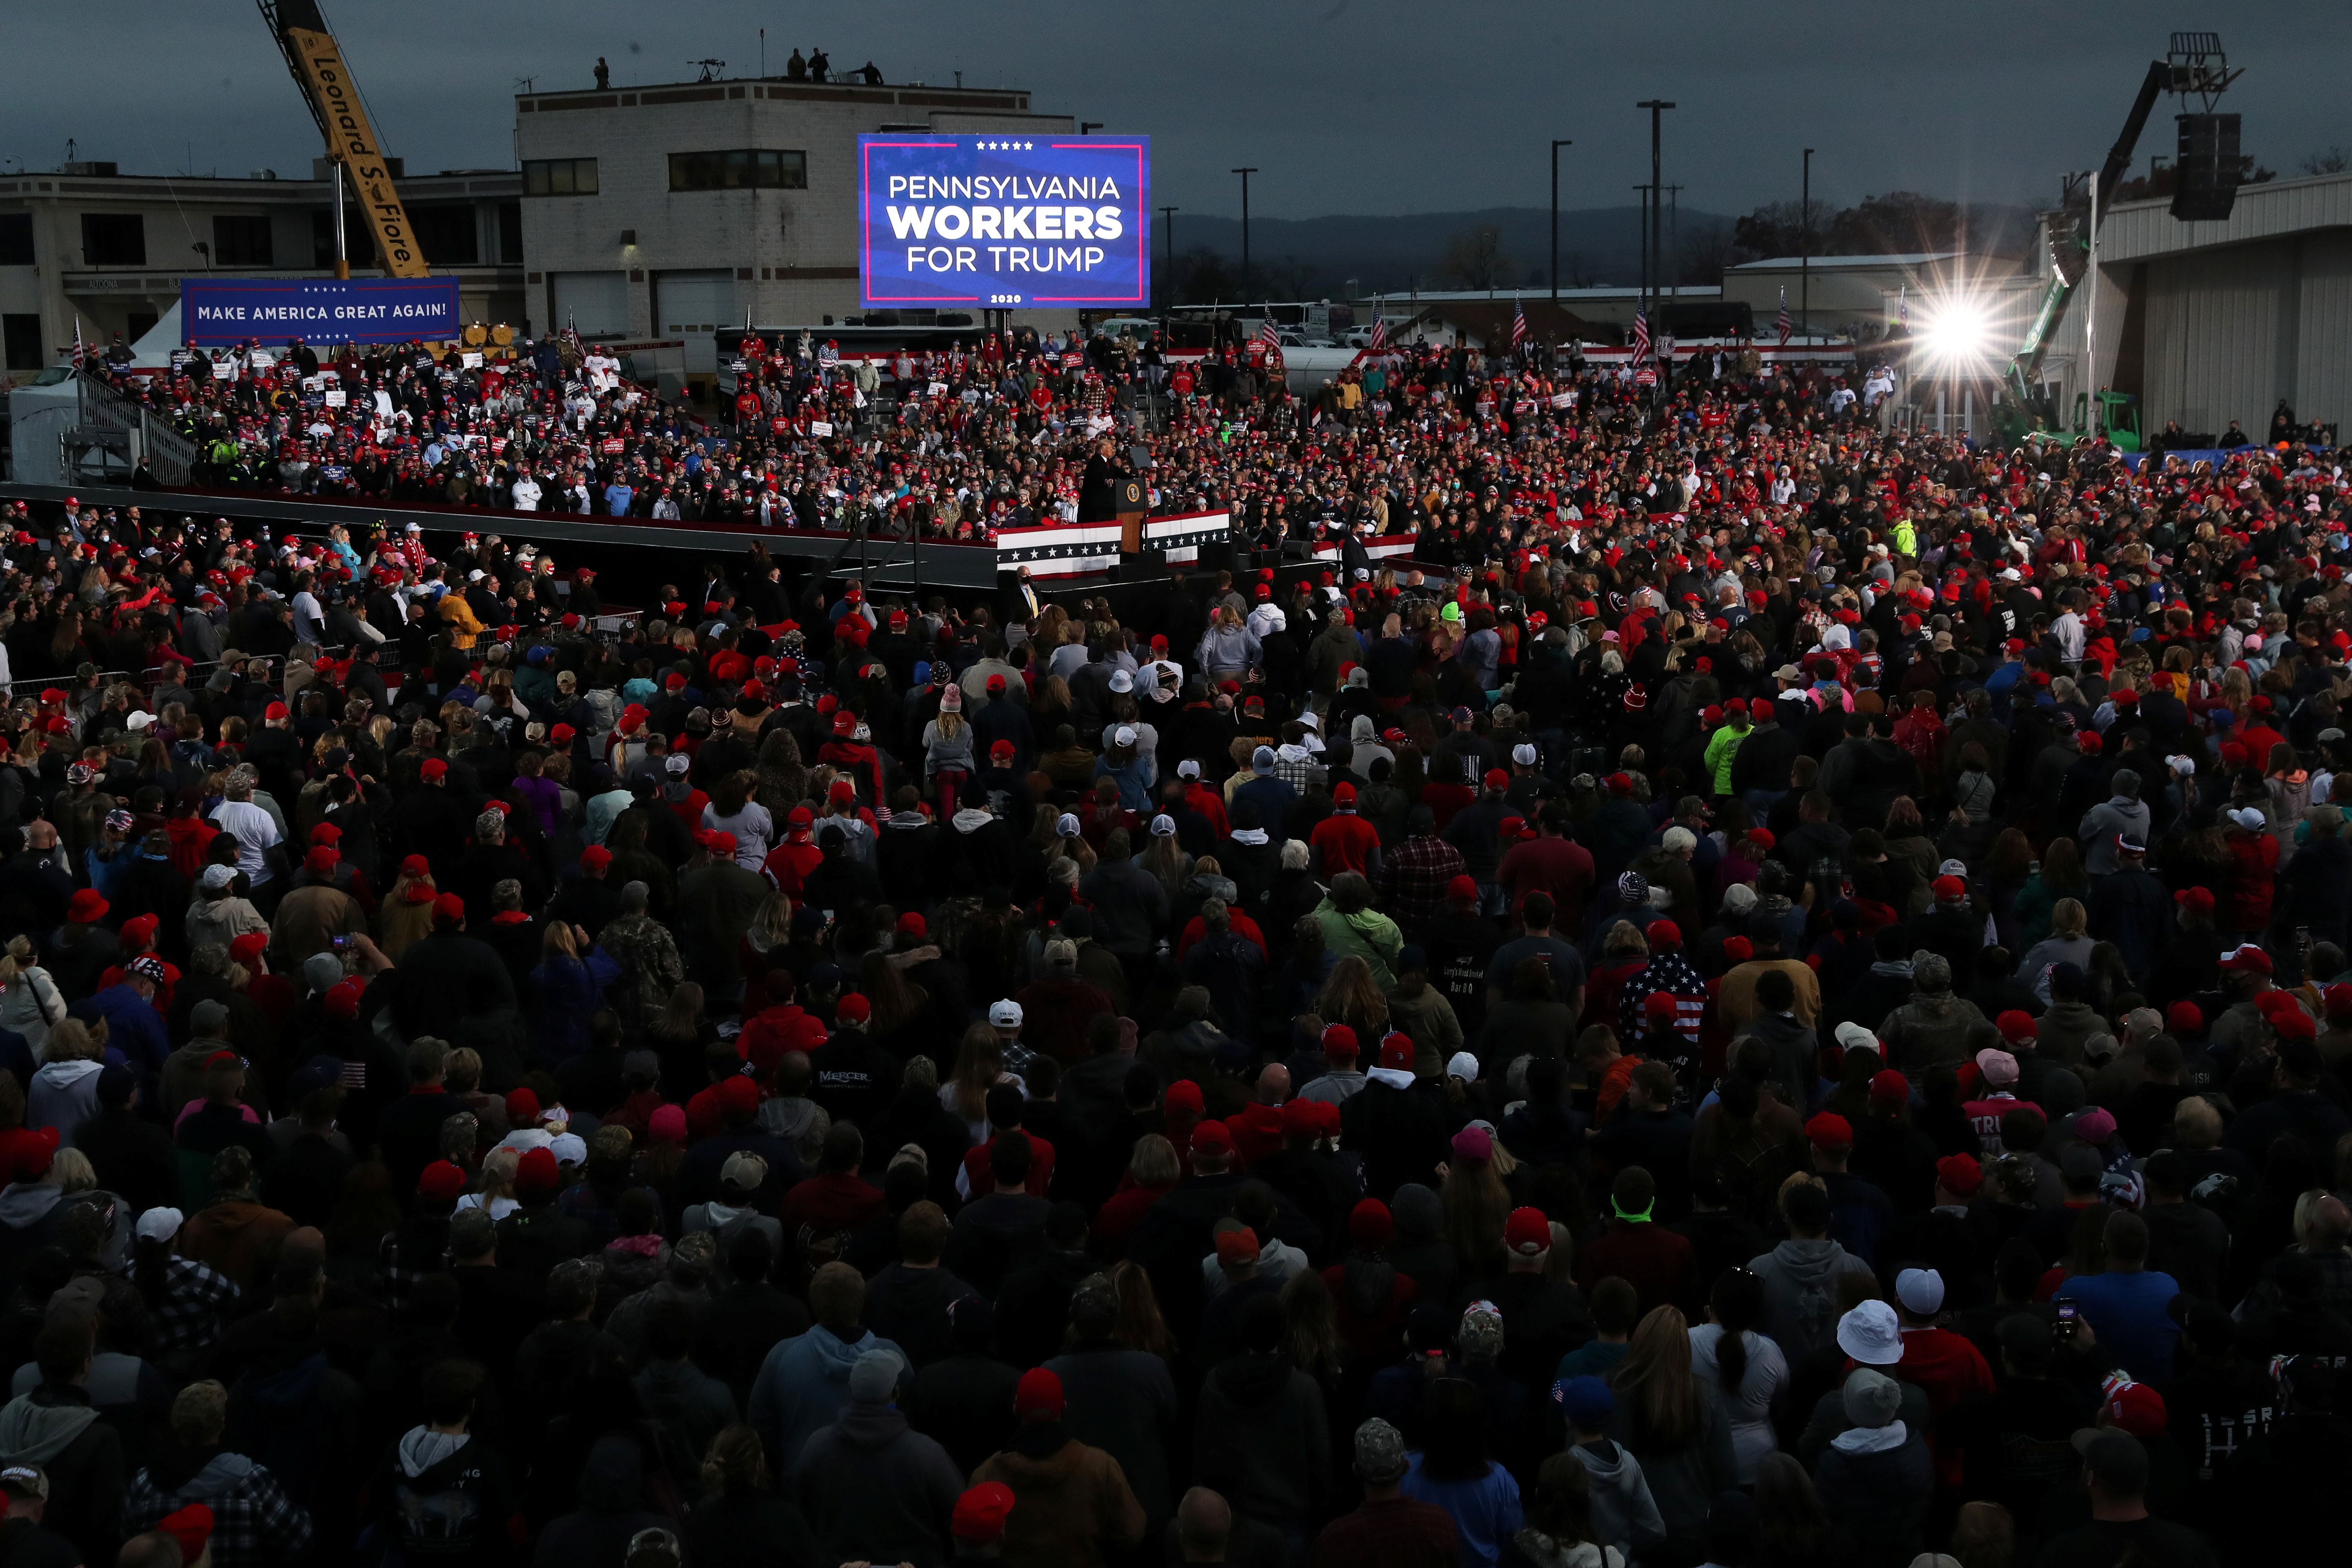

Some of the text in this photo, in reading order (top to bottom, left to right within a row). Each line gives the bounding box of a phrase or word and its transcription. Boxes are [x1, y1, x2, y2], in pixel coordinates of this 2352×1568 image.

[313, 57, 375, 157] Leonard
[375, 204, 411, 267] Fiore,
[890, 176, 1120, 199] PENNSYLVANIA
[886, 206, 1122, 239] WORKERS
[908, 247, 1103, 272] FOR TRUMP
[89, 279, 118, 289] ALTOONA
[168, 279, 181, 288] BLA
[198, 303, 446, 320] MAKE AMERICA GREAT AGAIN!
[2035, 292, 2055, 332] SUNBELT
[1444, 966, 1483, 979] Larry's Wood Smoked
[1451, 981, 1461, 992] Bar
[818, 1070, 873, 1083] MERCER
[2195, 1072, 2210, 1084] ISH
[1970, 1115, 2001, 1134] TRU
[2334, 1356, 2347, 1369] R
[2261, 1406, 2272, 1422] R
